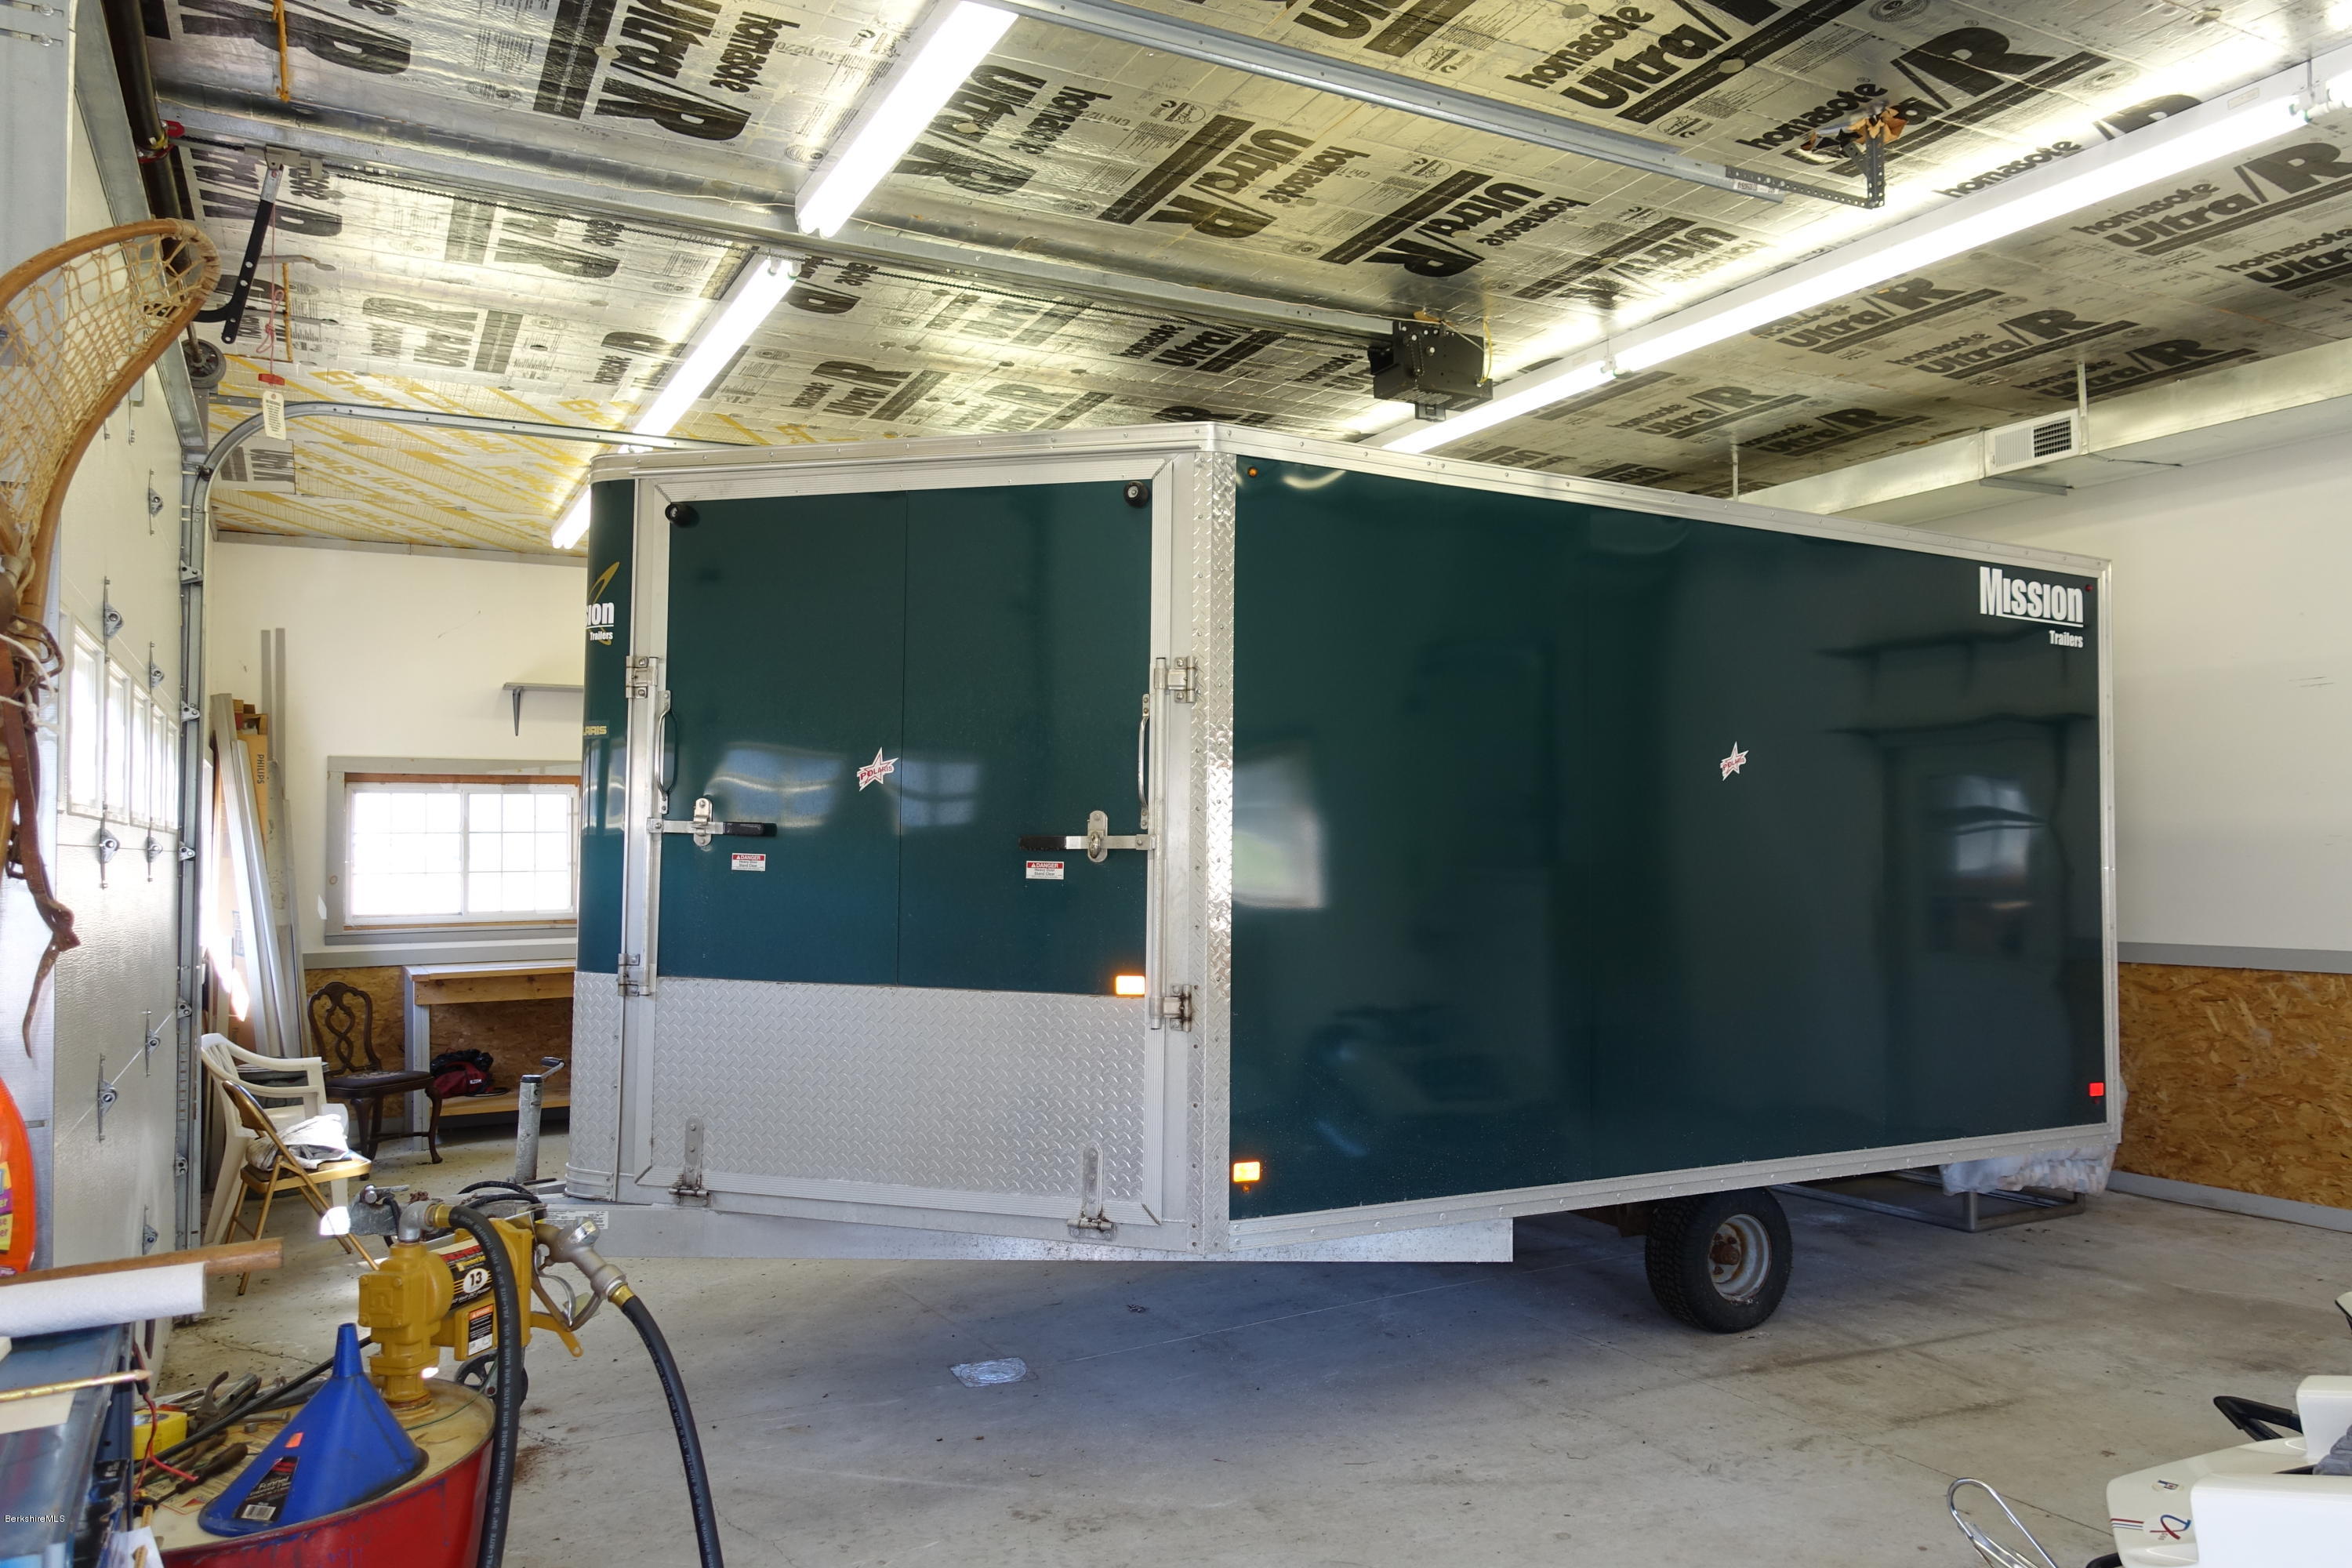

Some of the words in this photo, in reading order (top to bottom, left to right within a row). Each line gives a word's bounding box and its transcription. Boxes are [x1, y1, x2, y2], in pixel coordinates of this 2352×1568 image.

[709, 11, 800, 93] homasote
[1504, 6, 1655, 89] homasote
[1735, 83, 1888, 151] homasote
[1145, 129, 1316, 238] Ultra/R
[1259, 146, 1371, 204] homasote
[2102, 142, 2352, 247] Ultra/R
[1361, 183, 1546, 278] Ultra/R
[1477, 196, 1592, 246] homasote
[2070, 183, 2221, 235] homasote
[1775, 278, 1968, 350] Ultra/R
[1913, 309, 2104, 373] Ultra/R
[811, 361, 913, 416] Ultra/R
[1980, 566, 2084, 625] Mission
[590, 631, 614, 641] Trailers
[2049, 630, 2084, 648] Trailers
[860, 765, 893, 781] POLARIS
[470, 1272, 483, 1287] 13
[497, 1451, 506, 1484] TRANSFER
